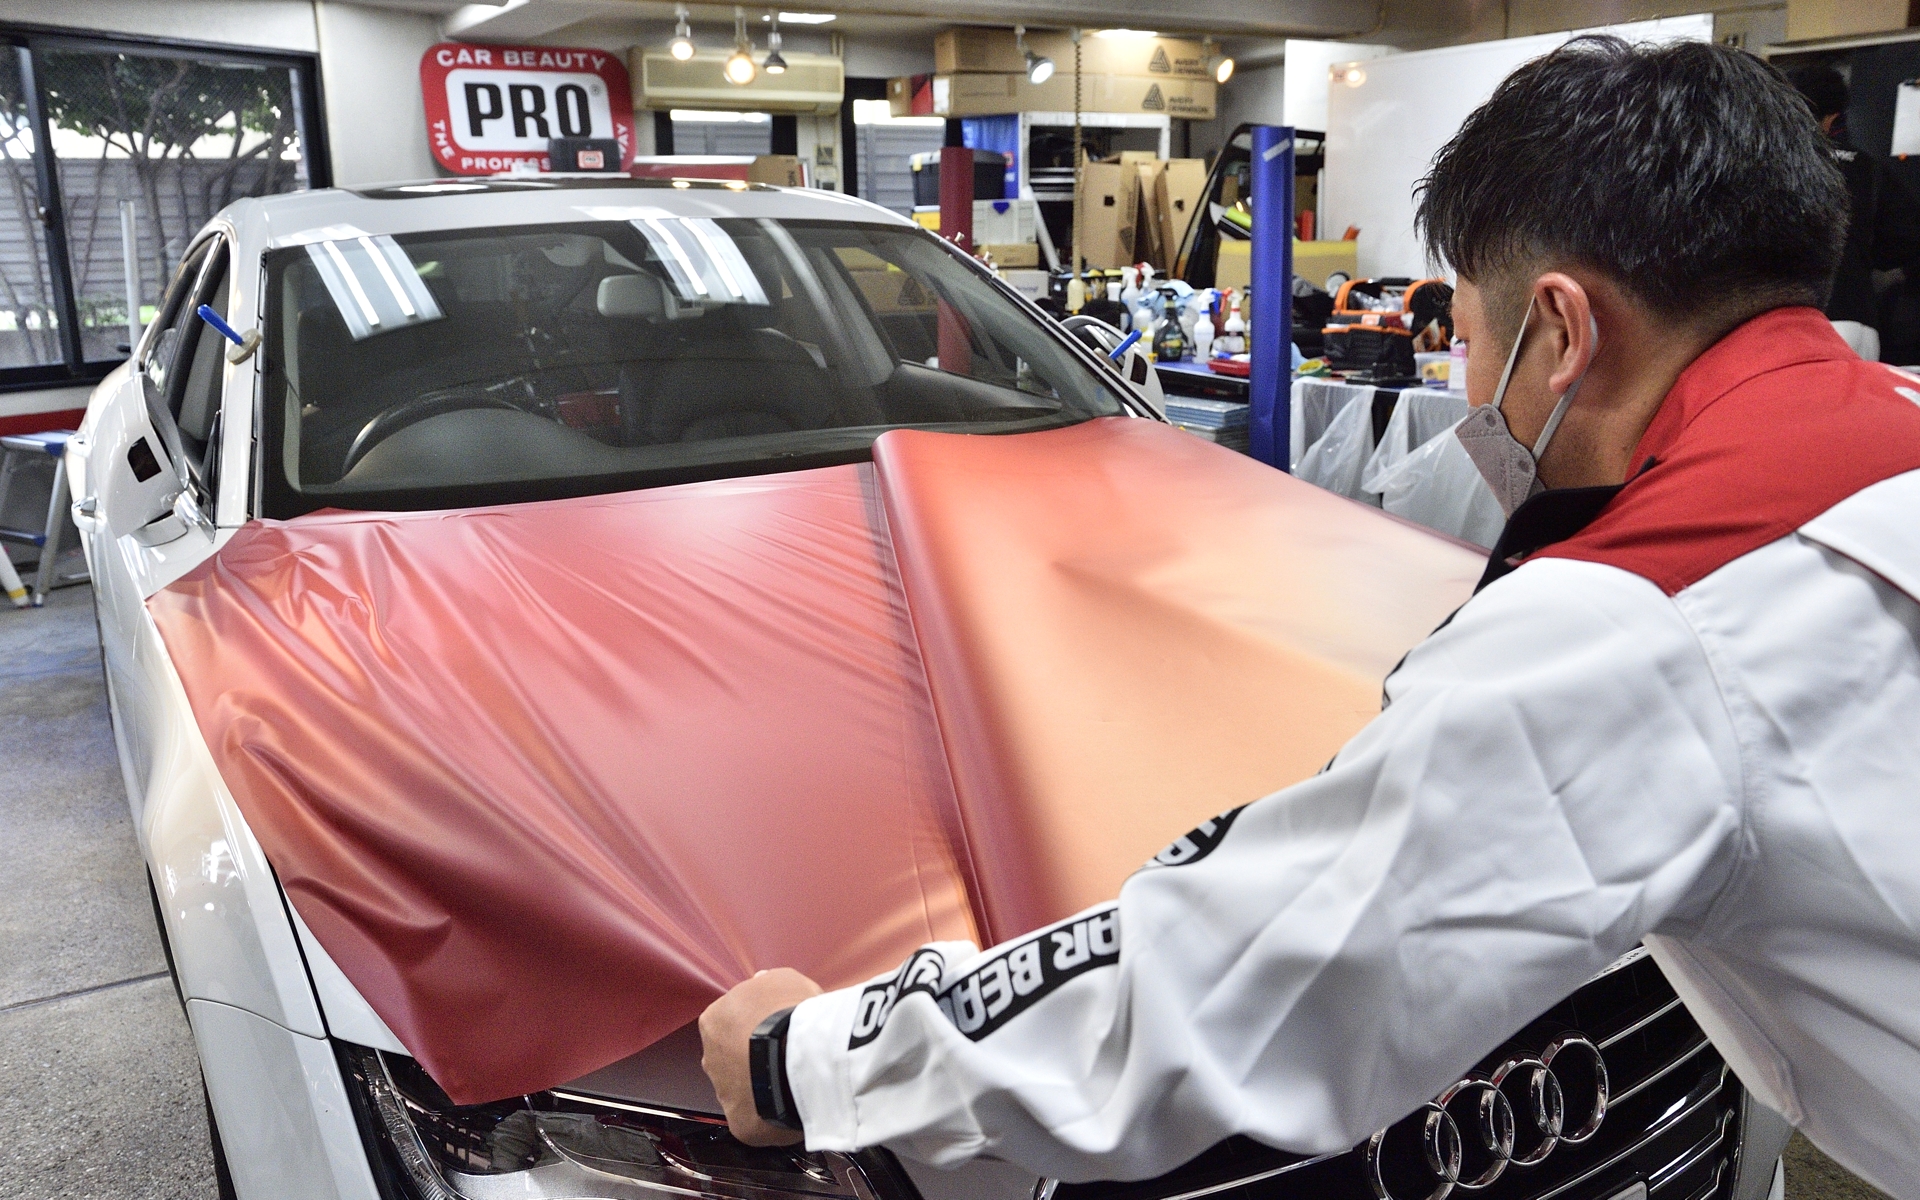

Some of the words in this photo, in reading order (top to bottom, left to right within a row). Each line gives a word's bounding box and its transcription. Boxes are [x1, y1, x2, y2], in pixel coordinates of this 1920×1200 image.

[436, 49, 492, 66] CAR
[503, 51, 606, 69] BEAUTY
[463, 83, 592, 137] PRO
[433, 119, 456, 160] THE
[461, 156, 549, 171] PROFESS
[1052, 911, 1120, 971] AR
